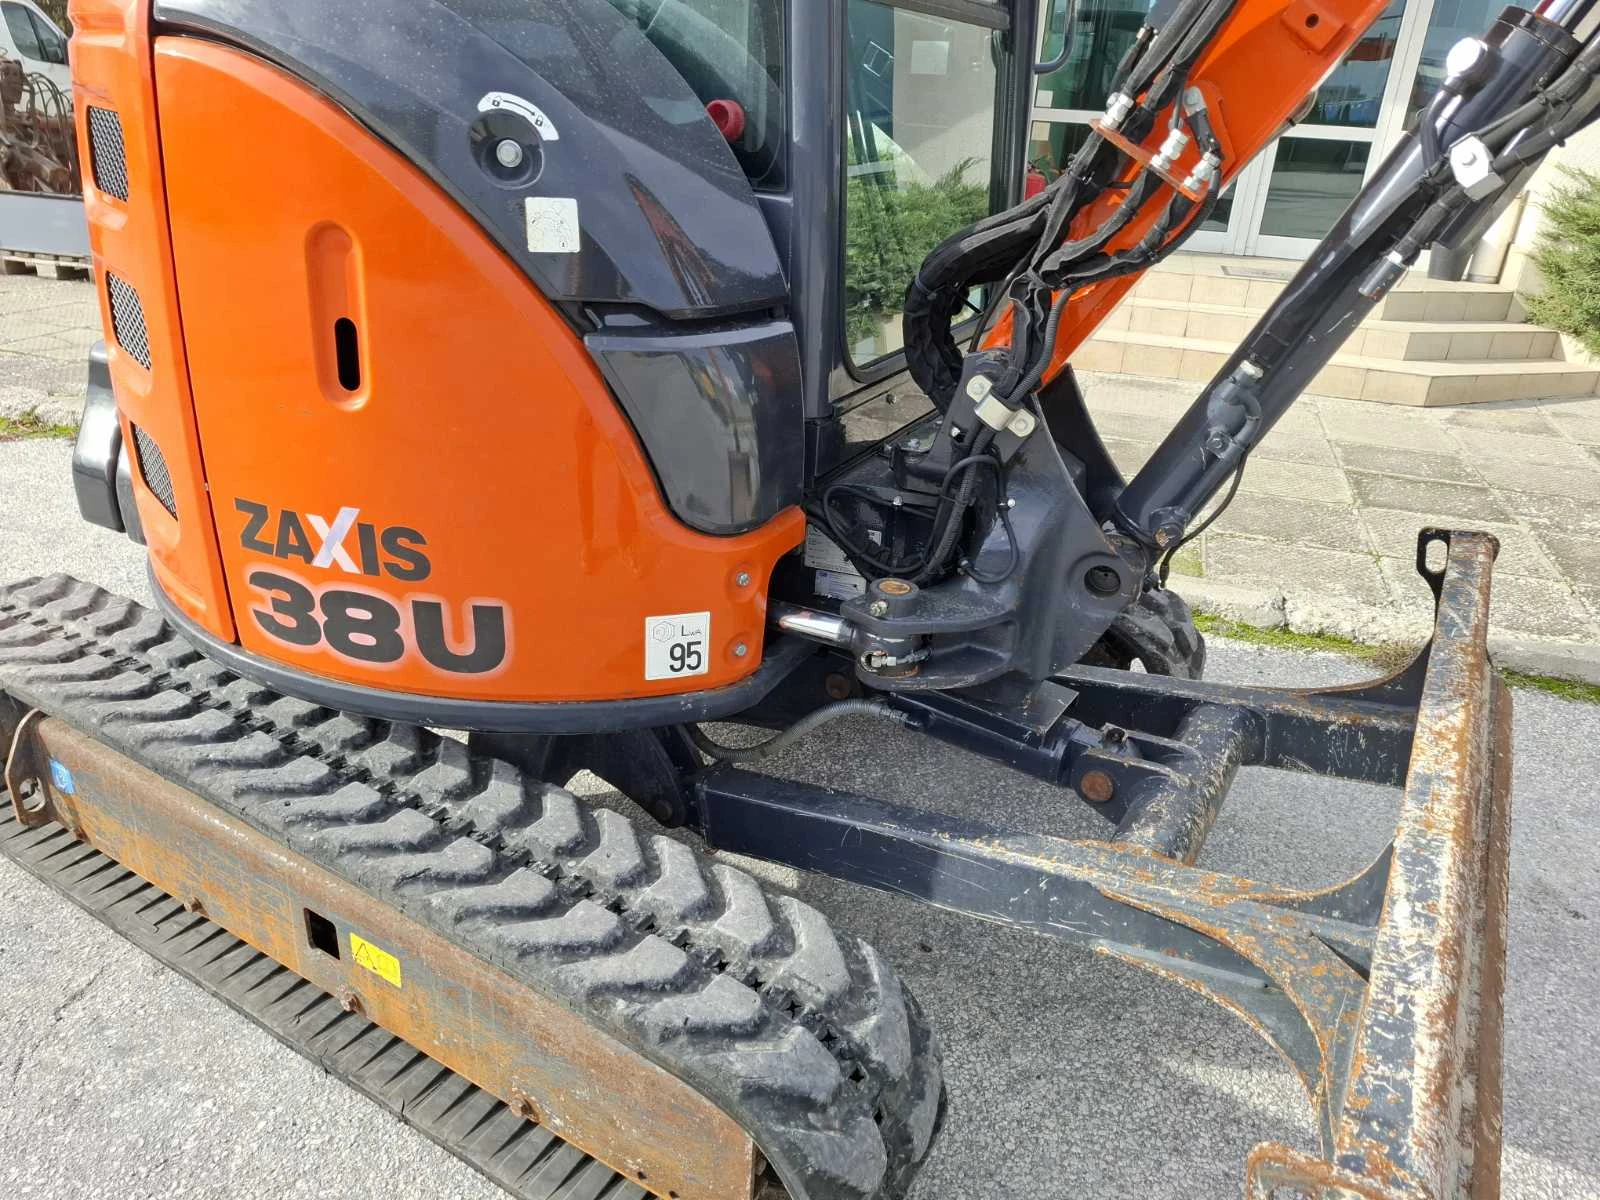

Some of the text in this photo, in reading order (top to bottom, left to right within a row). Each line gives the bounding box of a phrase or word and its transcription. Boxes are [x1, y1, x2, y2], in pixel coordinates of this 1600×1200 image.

[234, 497, 431, 581] ZAXIS
[249, 571, 506, 674] 38U
[669, 641, 702, 672] 95
